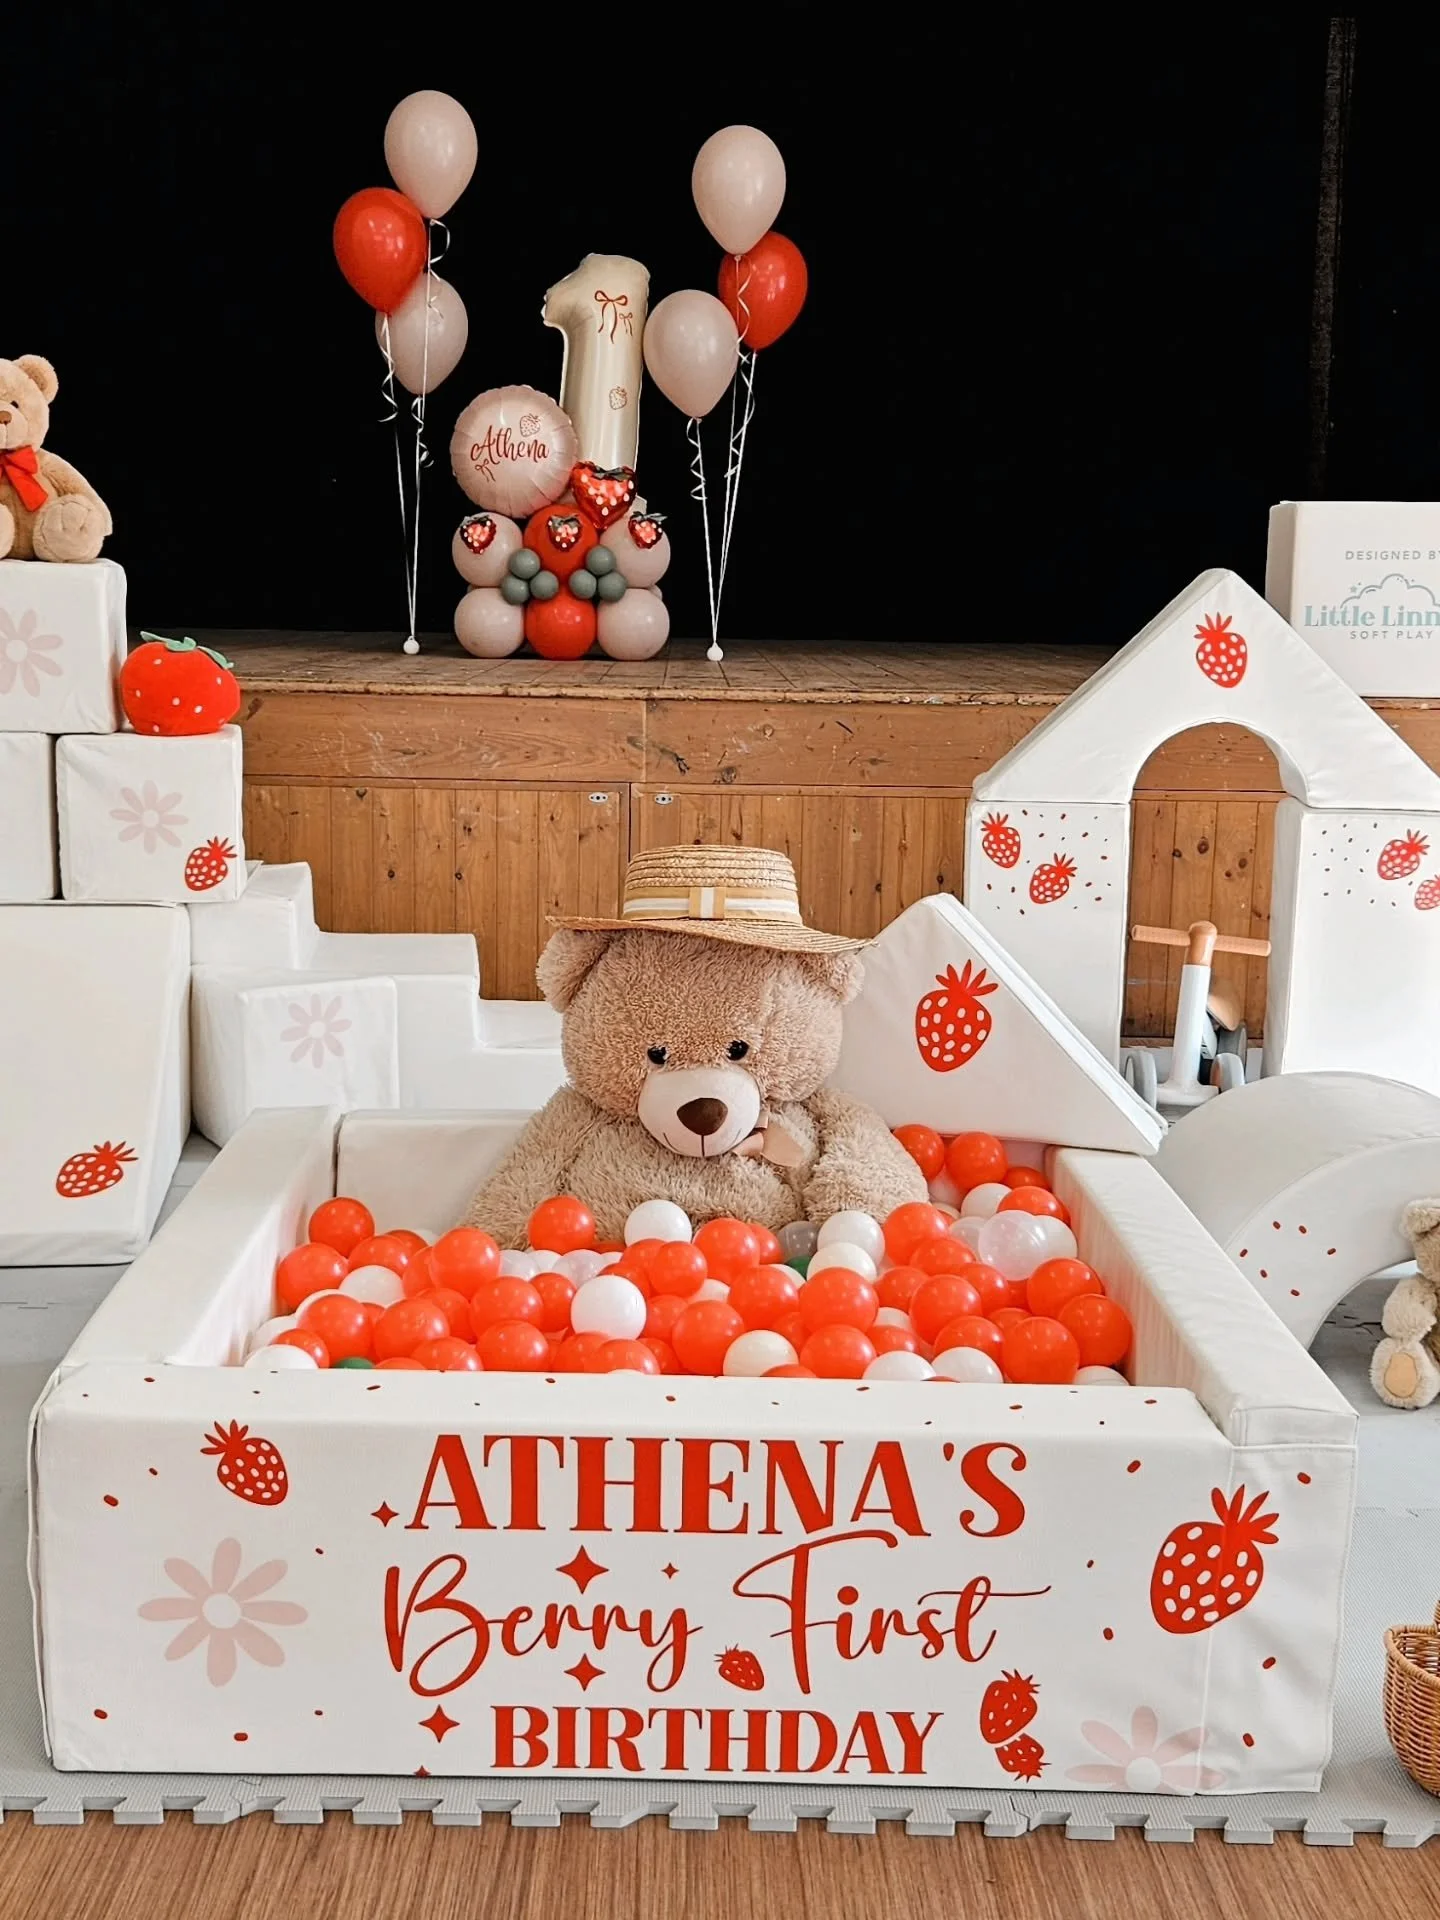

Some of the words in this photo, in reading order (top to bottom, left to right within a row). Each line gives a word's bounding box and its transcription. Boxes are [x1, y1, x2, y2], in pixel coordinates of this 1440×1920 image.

[470, 424, 550, 465] Athena
[1345, 550, 1421, 561] DESIGNED
[1304, 605, 1376, 627] Little
[1350, 630, 1389, 640] SOFT
[1396, 630, 1433, 640] PLAY
[404, 1433, 1028, 1538] ATHENA'S
[384, 1554, 703, 1697] Berry
[733, 1530, 1052, 1695] First
[489, 1705, 945, 1776] BIRTHDAY
